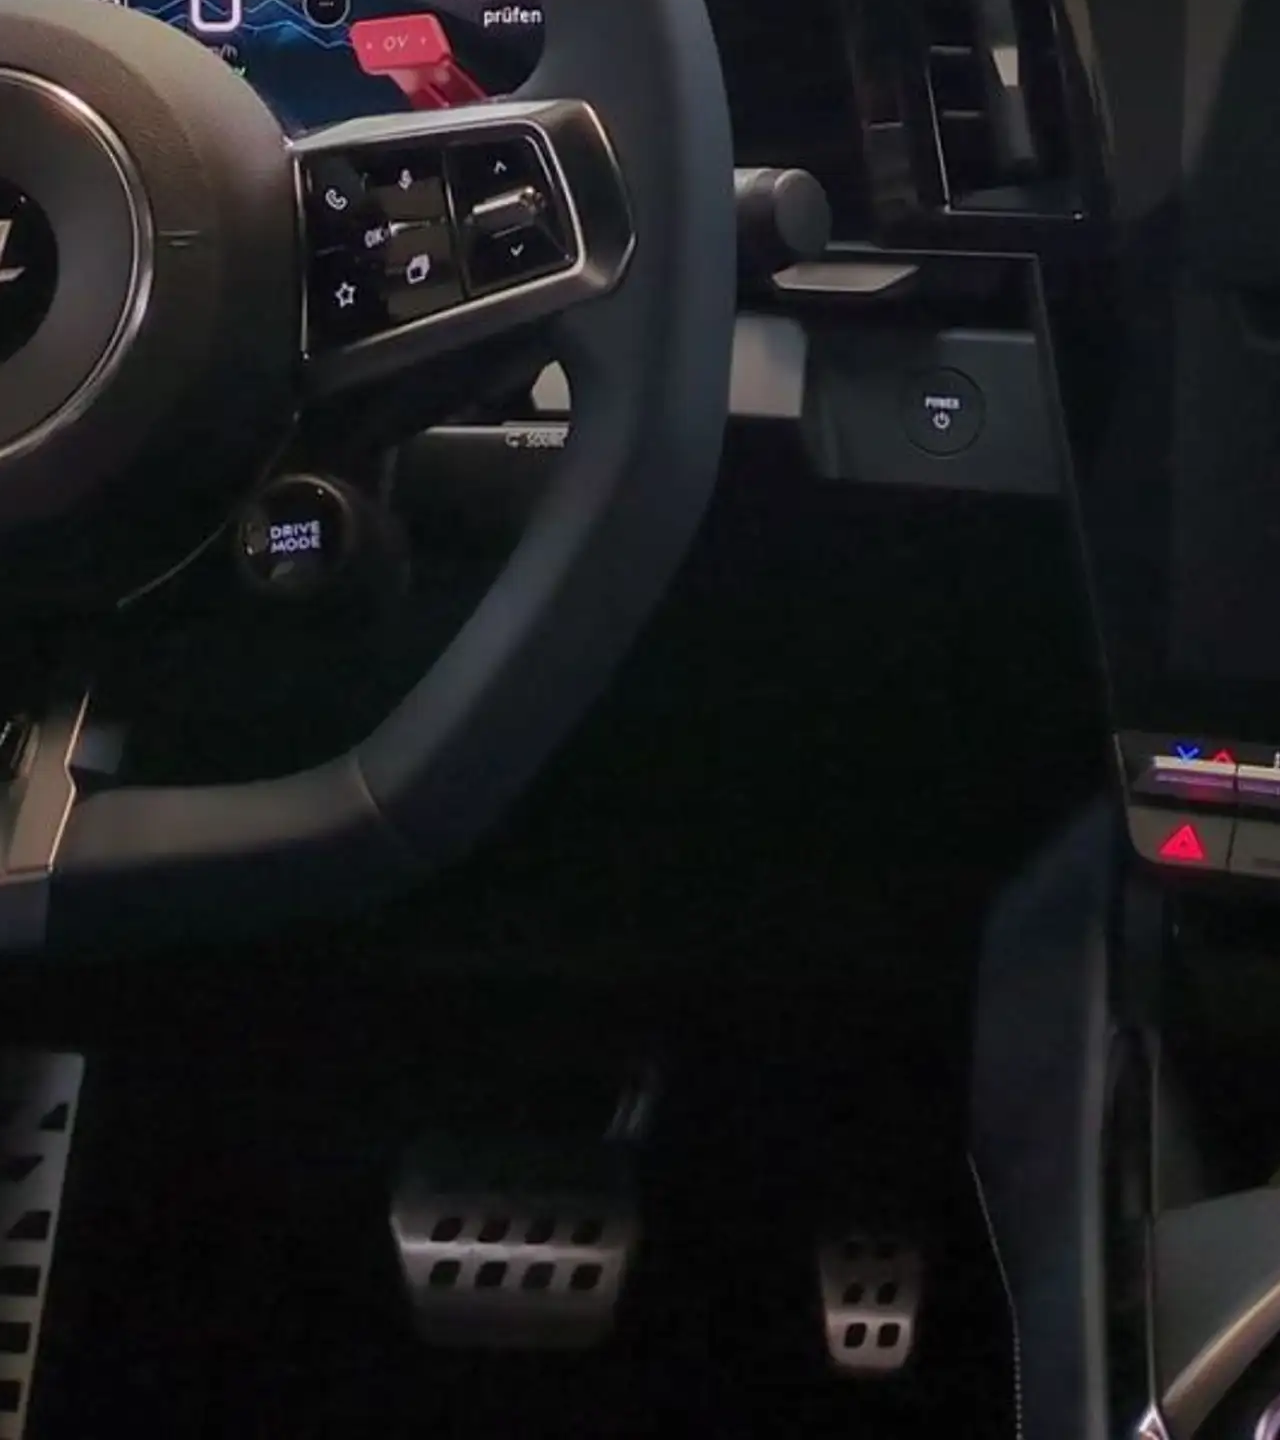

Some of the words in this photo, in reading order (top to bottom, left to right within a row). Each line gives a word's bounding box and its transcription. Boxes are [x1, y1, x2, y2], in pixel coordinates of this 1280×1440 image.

[483, 6, 543, 28] prüfen
[270, 520, 320, 540] DRIVE
[270, 535, 320, 554] MODE
